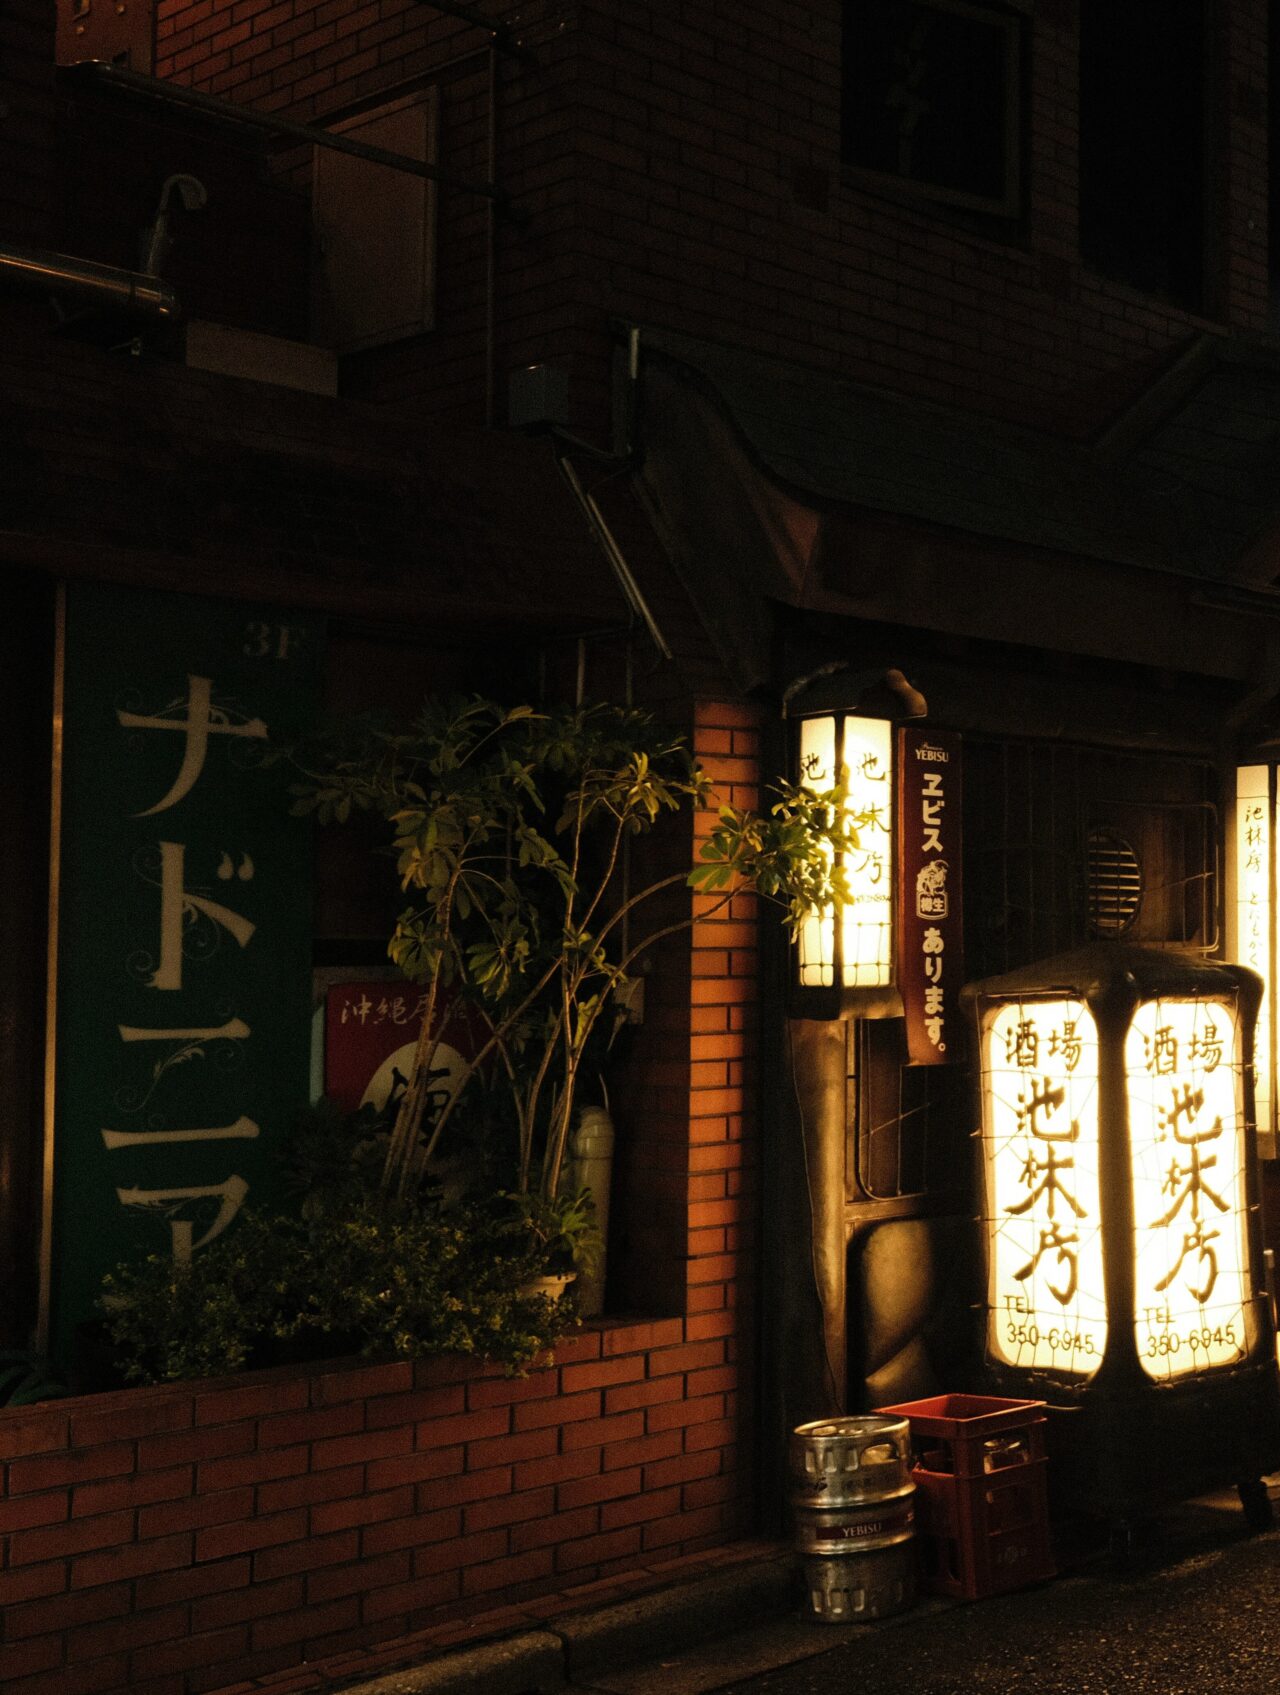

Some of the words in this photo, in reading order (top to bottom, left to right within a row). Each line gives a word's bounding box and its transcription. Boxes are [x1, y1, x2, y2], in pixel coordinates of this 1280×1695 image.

[243, 621, 303, 660] 3F
[914, 748, 949, 763] YEBISU
[921, 926, 946, 1052] あります。
[1005, 1018, 1083, 1071] 酒場
[1143, 1023, 1224, 1076] 酒場
[1003, 1294, 1035, 1315] TEL
[1142, 1306, 1176, 1324] TEL
[1007, 1322, 1095, 1355] 350-6945
[1147, 1324, 1236, 1358] 350-6945
[841, 1521, 882, 1538] YEBISU
